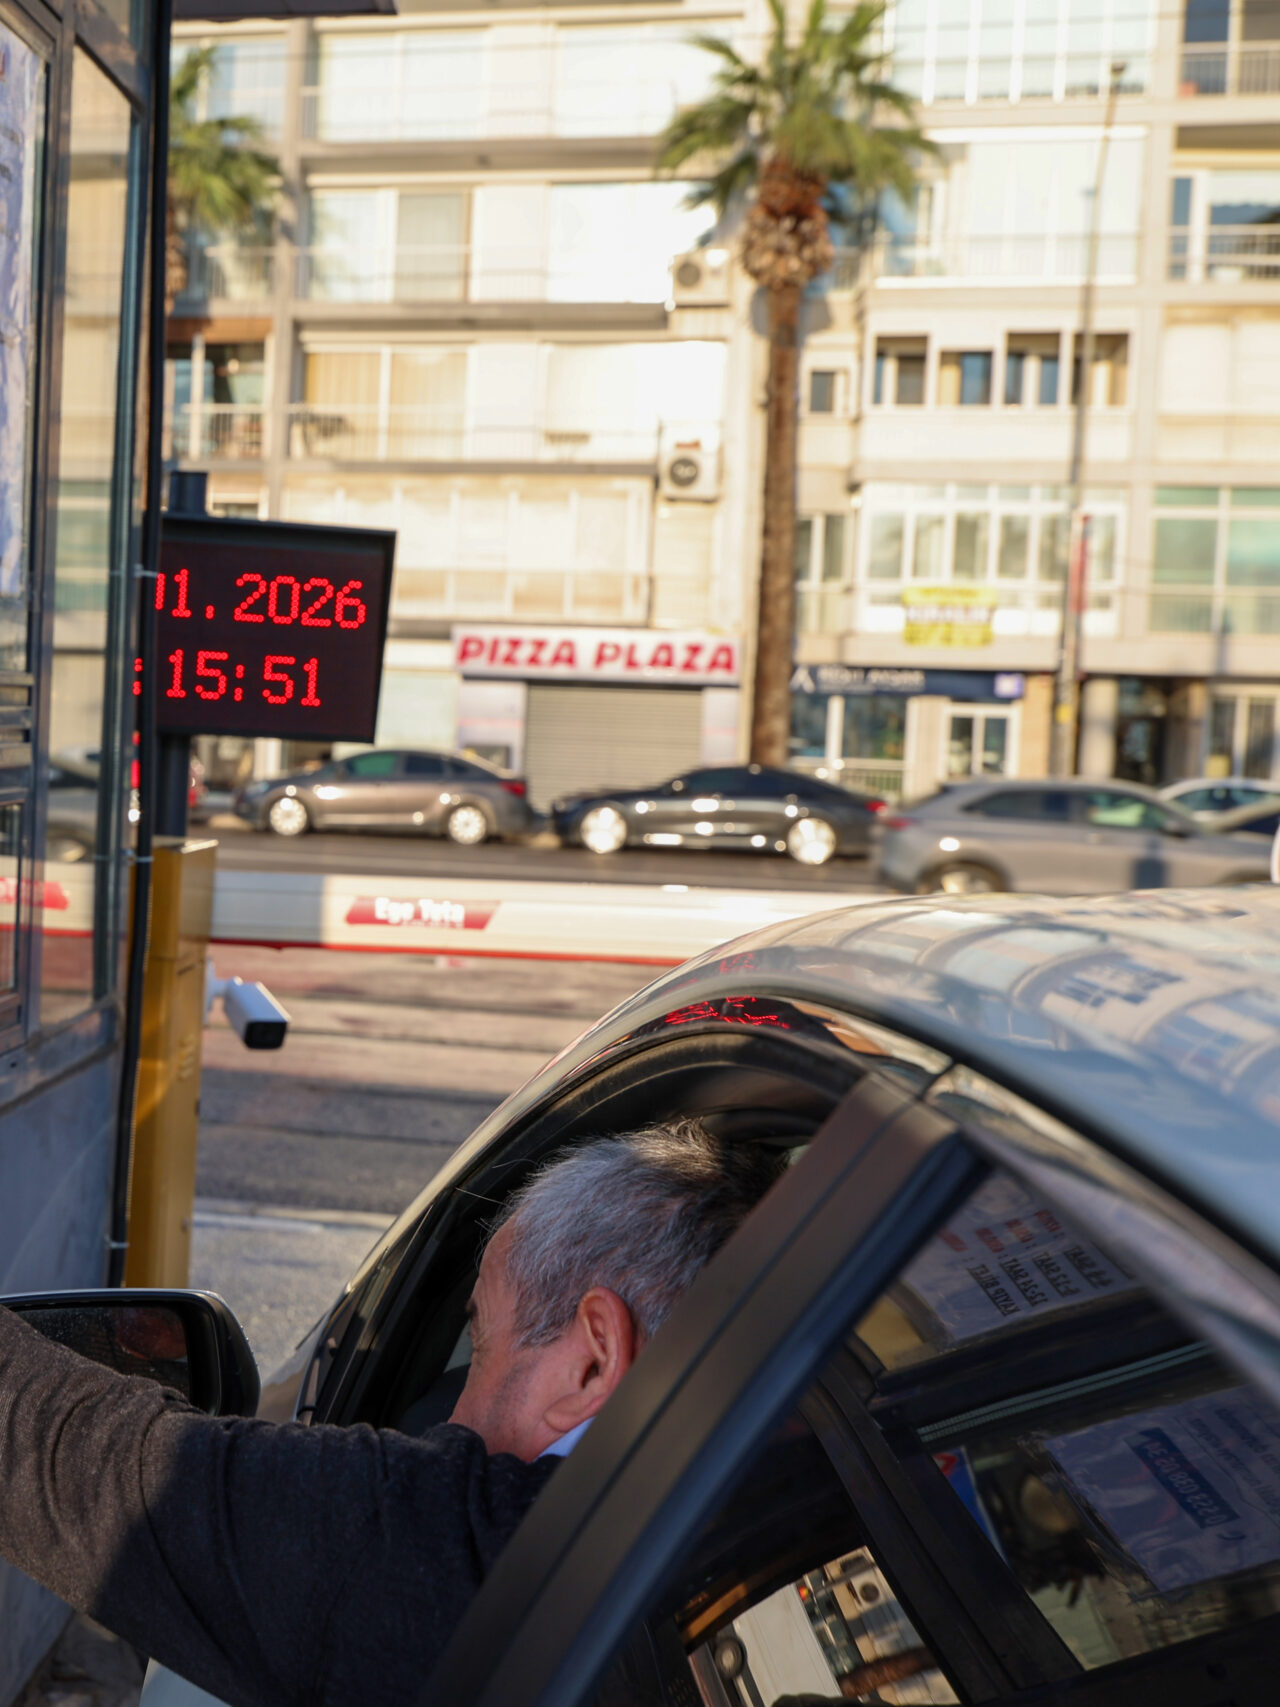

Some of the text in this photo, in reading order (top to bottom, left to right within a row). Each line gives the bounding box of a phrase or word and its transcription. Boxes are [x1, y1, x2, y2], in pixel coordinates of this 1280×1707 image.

[166, 649, 322, 708] 15:51
[456, 635, 736, 674] PIZZA PLAZA
